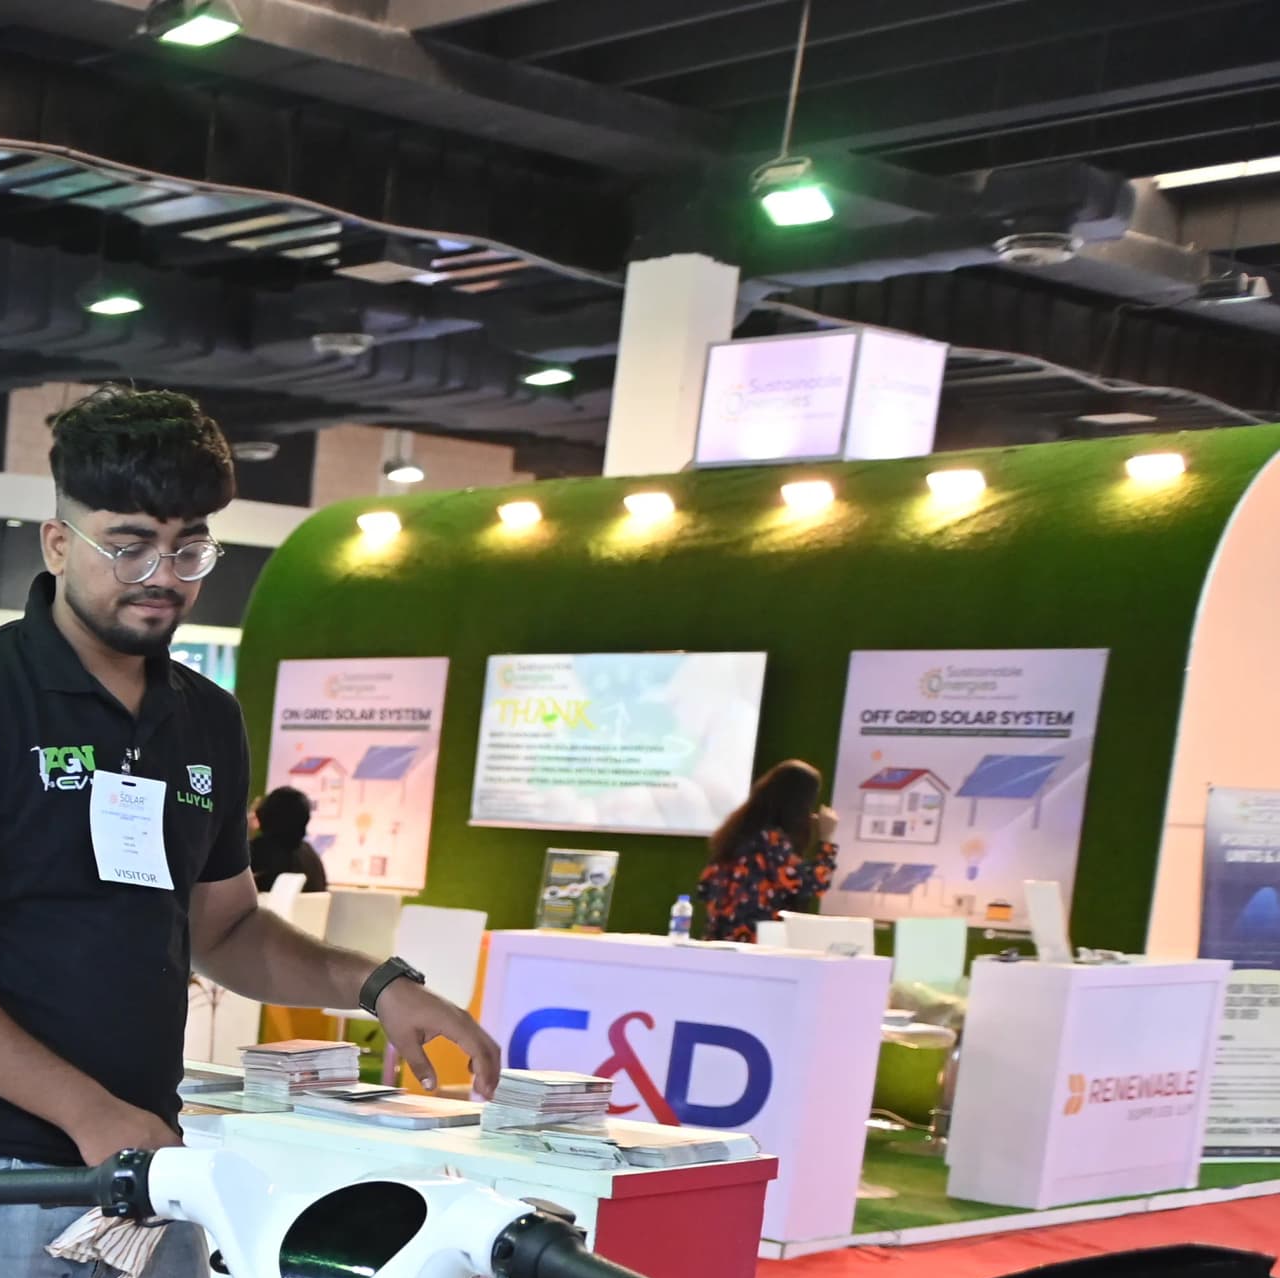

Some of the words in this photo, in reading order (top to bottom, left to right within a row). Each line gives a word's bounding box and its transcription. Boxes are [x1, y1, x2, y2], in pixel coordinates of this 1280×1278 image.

[336, 708, 376, 720] SOLAR
[380, 708, 432, 720] SYSTEM
[860, 709, 891, 723] OFF
[895, 710, 936, 724] GRID
[940, 710, 997, 725] SOLAR
[1000, 710, 1075, 726] SYSTEM
[177, 790, 213, 812] LUYU
[114, 868, 157, 883] VISITOR
[1089, 1070, 1197, 1104] RENEWABLE
